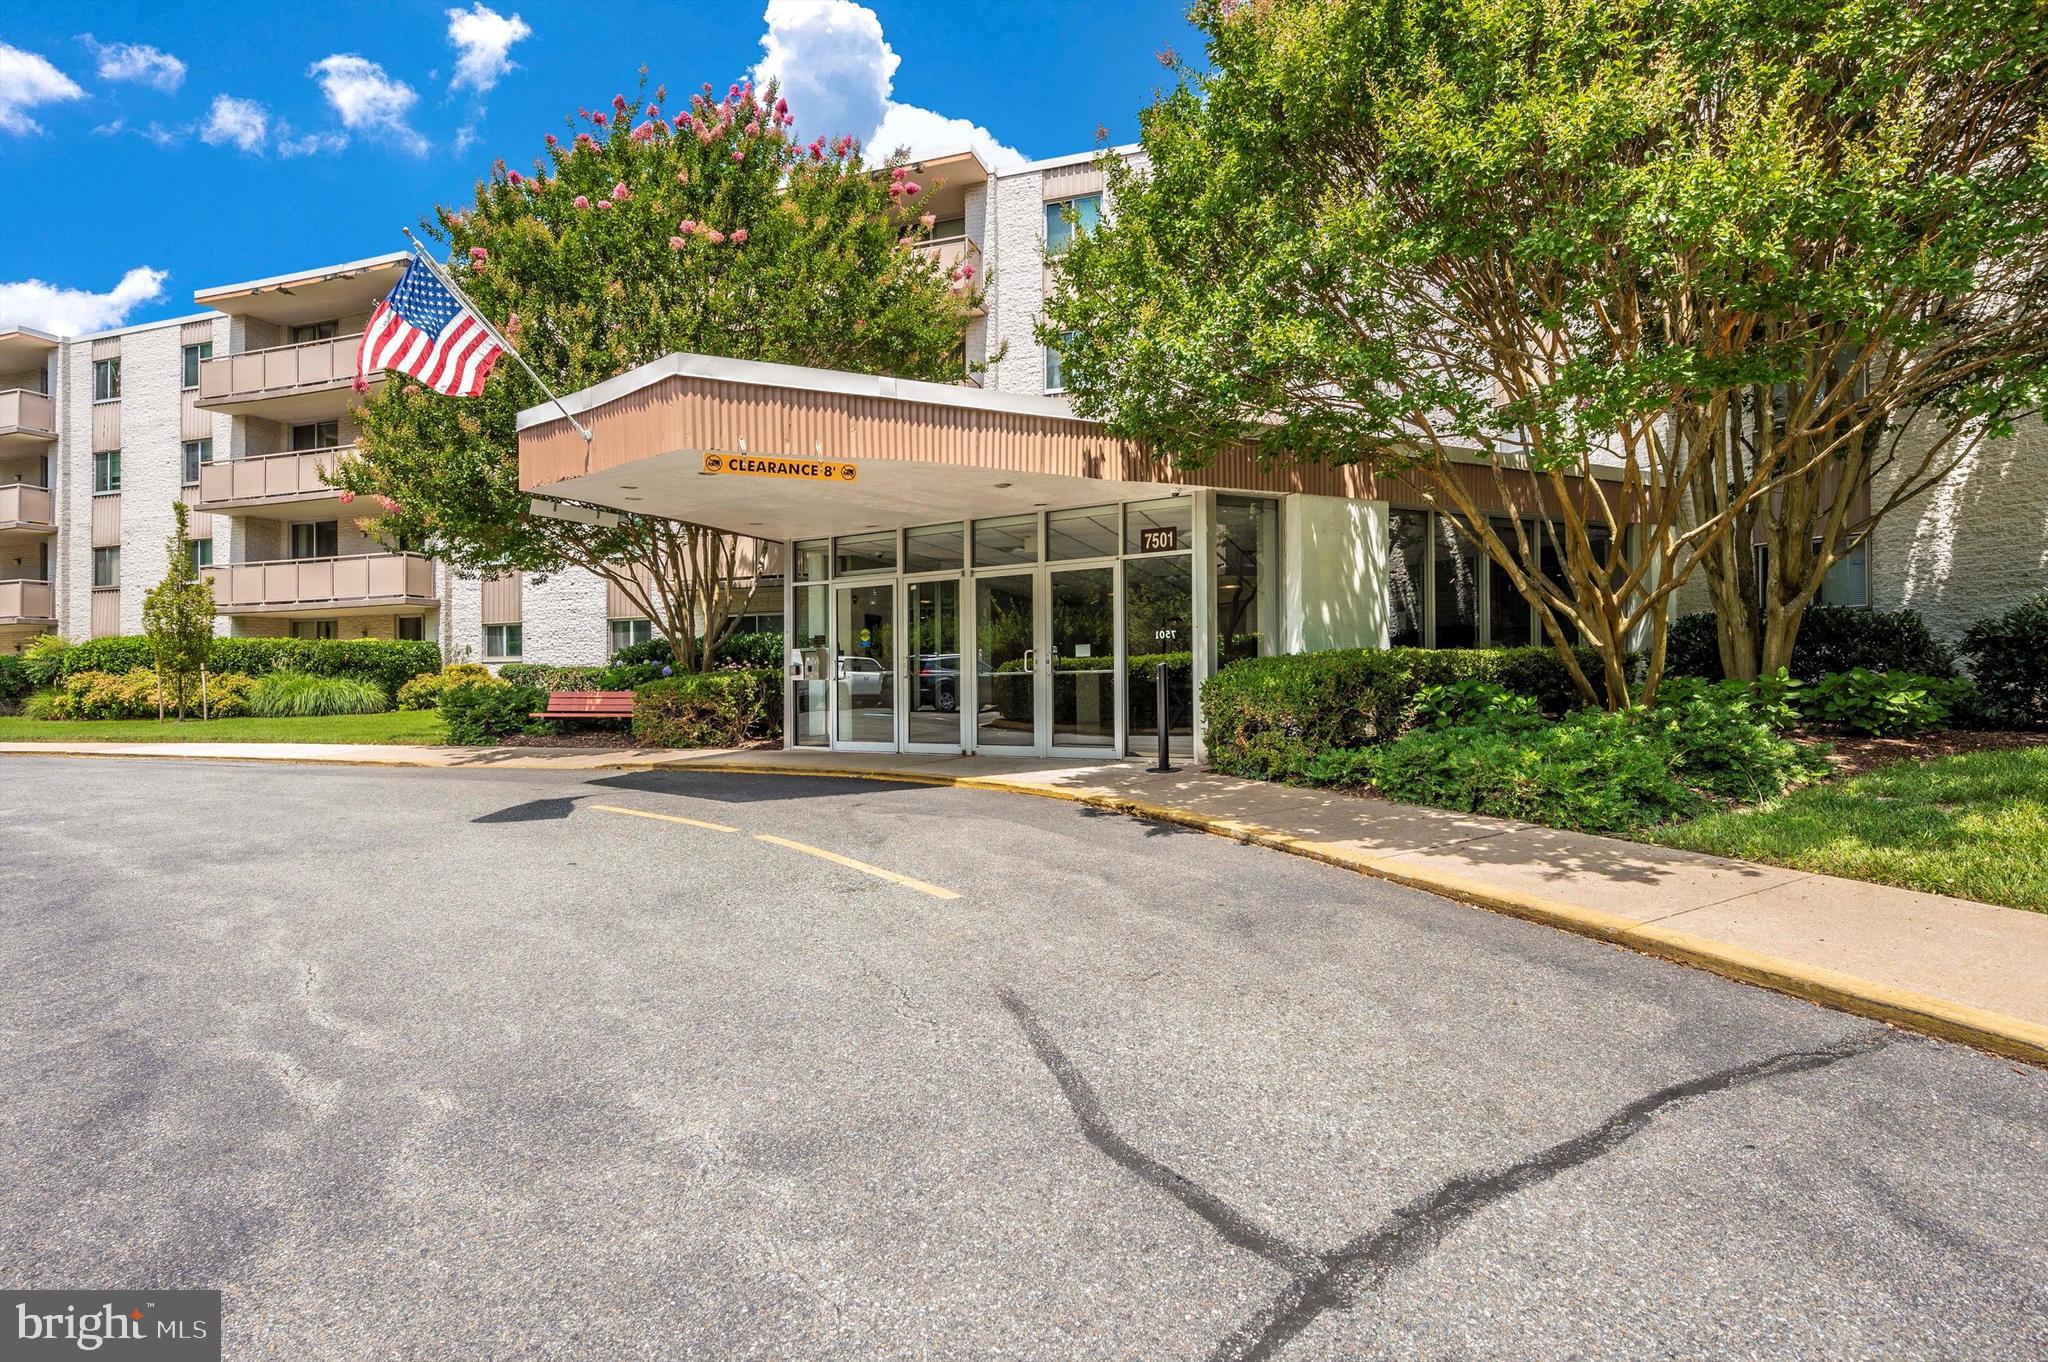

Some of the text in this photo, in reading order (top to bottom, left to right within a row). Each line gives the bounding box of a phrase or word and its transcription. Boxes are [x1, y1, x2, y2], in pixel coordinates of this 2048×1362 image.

[729, 459, 836, 477] CLEARANCE 8'
[1144, 531, 1174, 549] 7501
